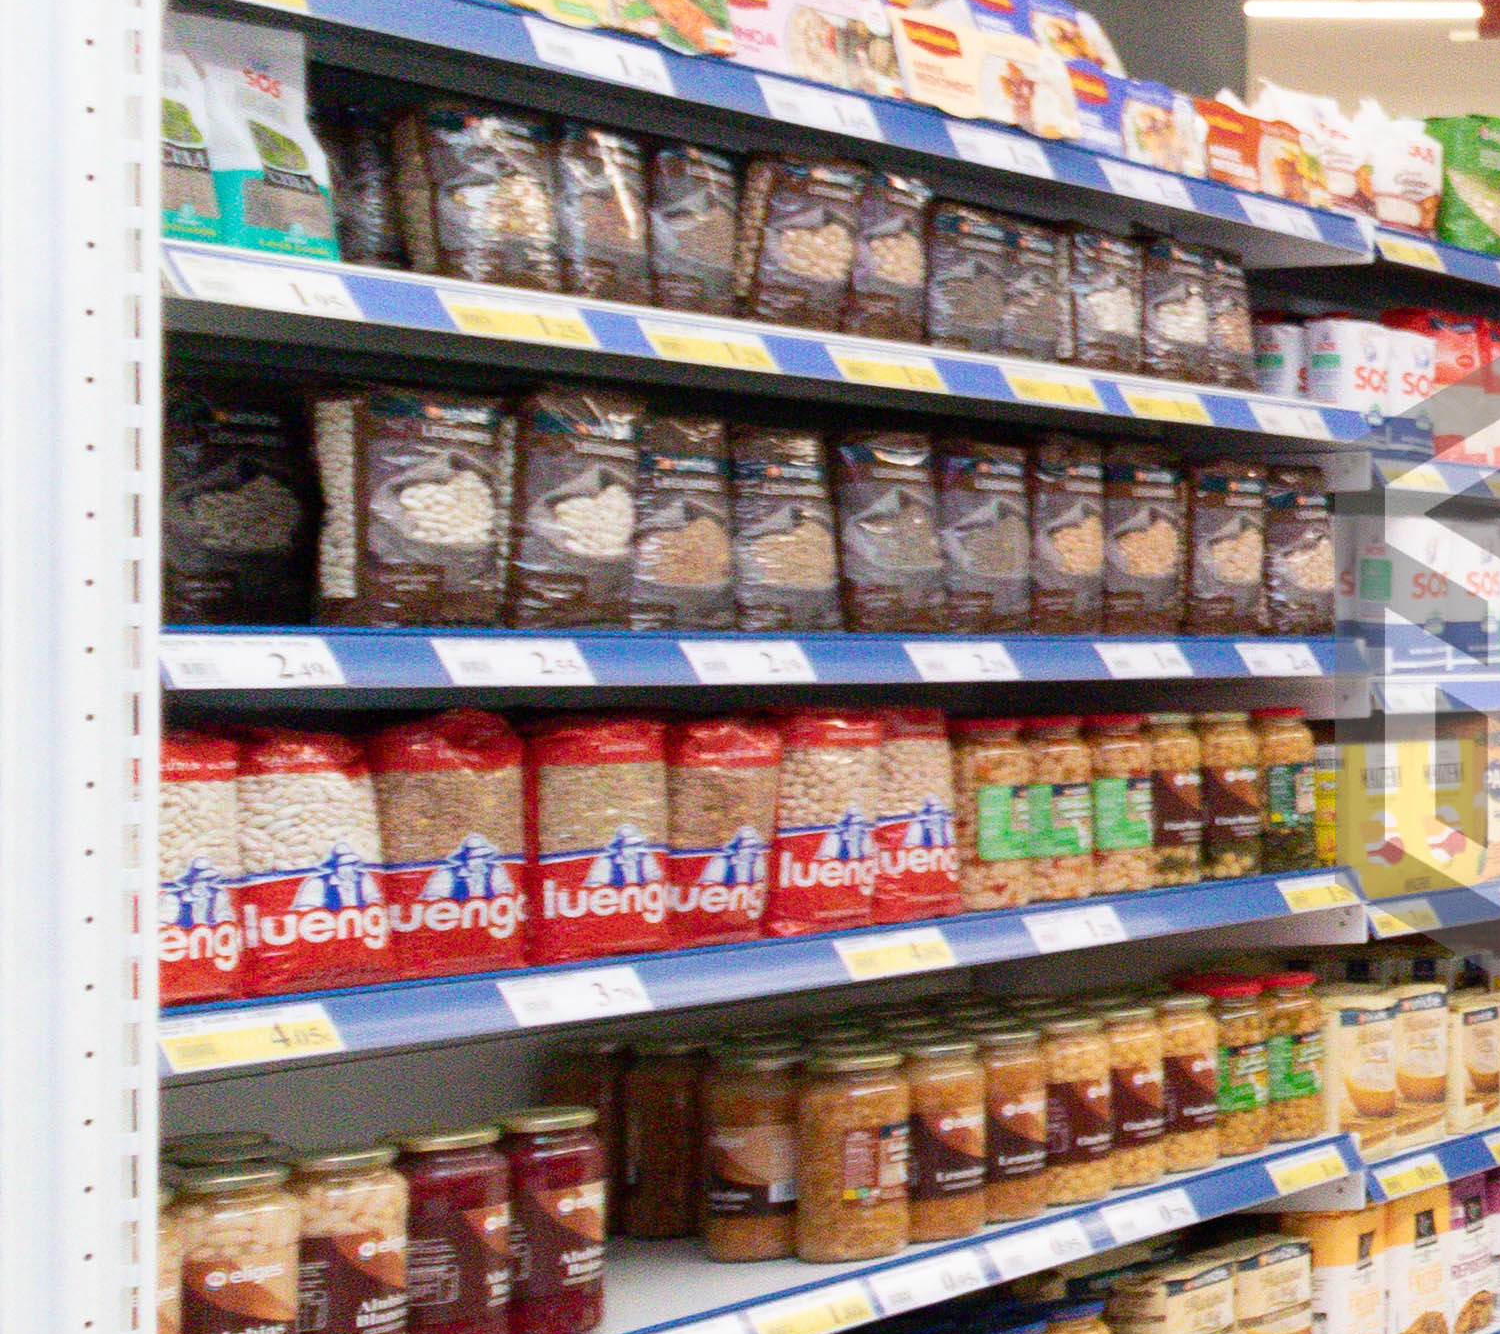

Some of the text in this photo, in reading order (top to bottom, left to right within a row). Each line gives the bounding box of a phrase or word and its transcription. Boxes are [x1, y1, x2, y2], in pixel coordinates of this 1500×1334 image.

[1401, 372, 1433, 398] SO
[779, 850, 876, 896] lueng
[543, 878, 665, 925] lueng
[244, 903, 388, 950] lueng
